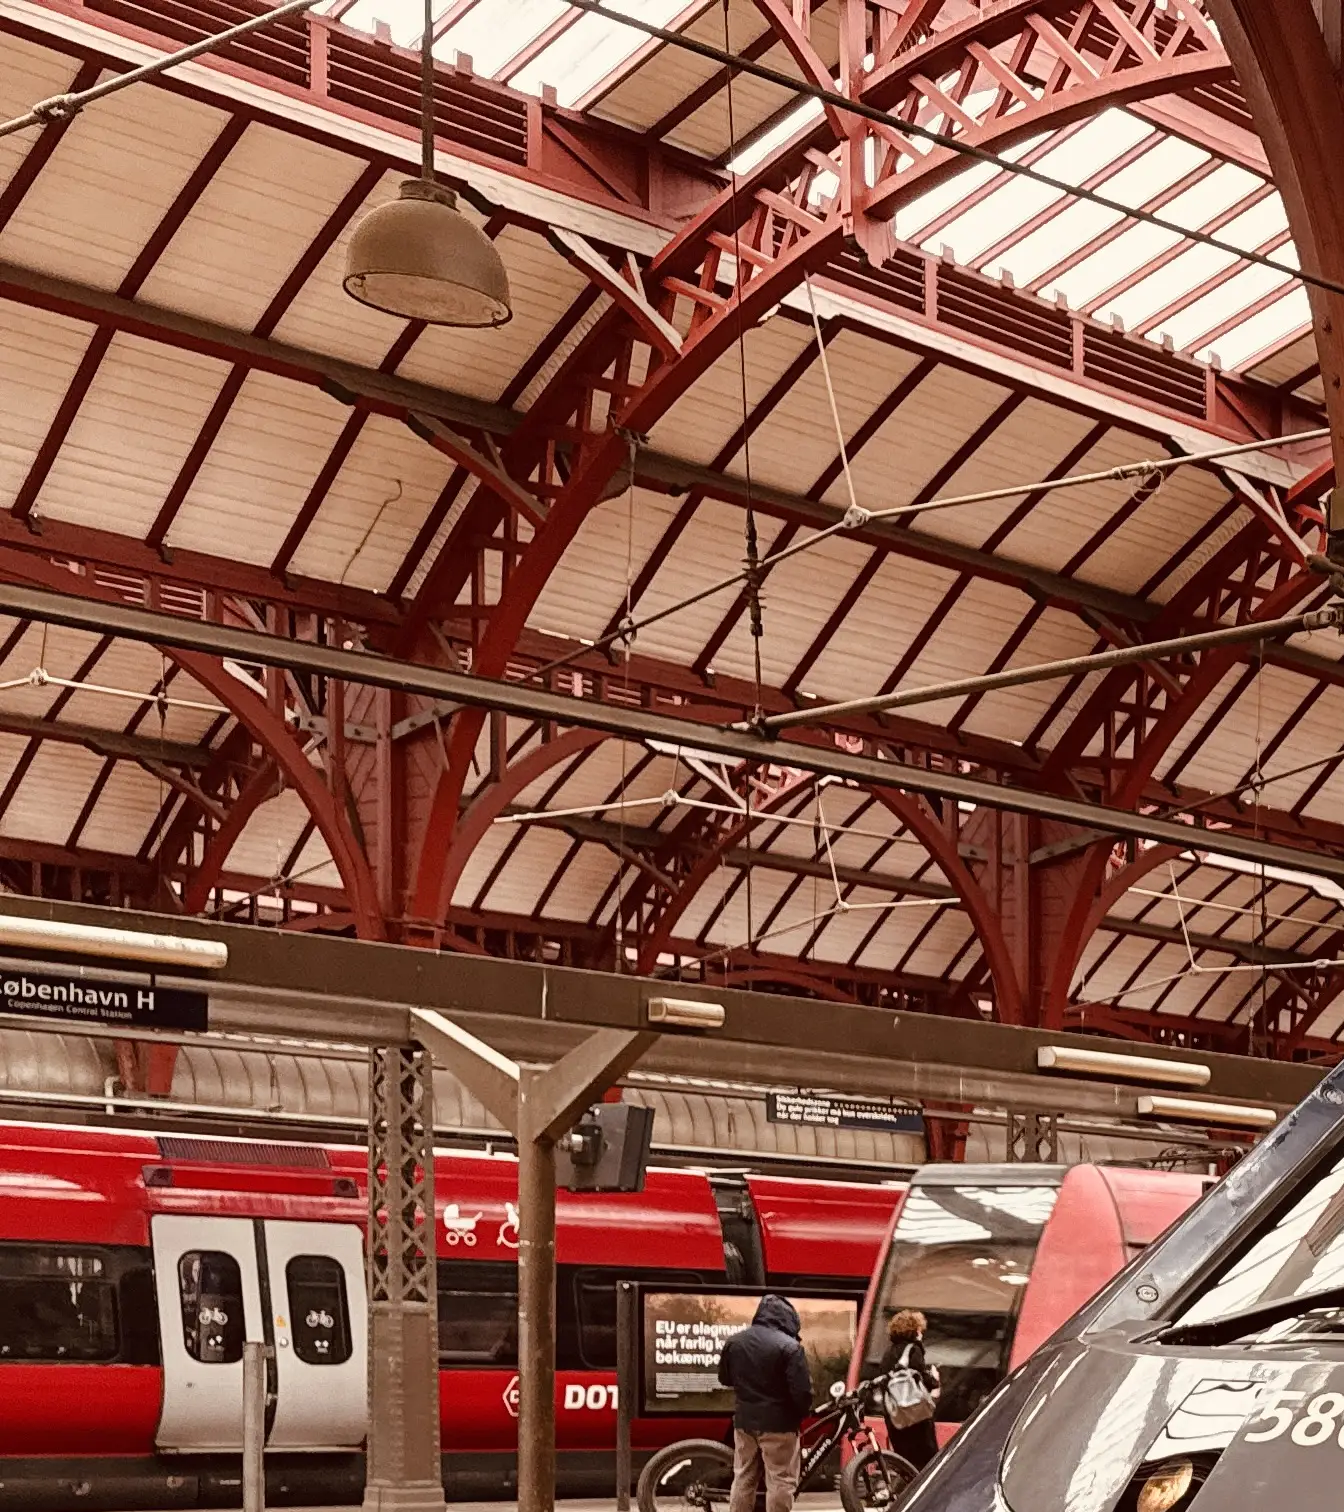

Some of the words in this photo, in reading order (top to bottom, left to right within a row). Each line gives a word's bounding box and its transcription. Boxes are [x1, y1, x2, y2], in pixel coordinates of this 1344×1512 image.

[0, 975, 128, 1008] øbenhavn
[137, 990, 155, 1011] H
[8, 998, 64, 1013] Copenhagen
[66, 1004, 98, 1016] Central
[100, 1008, 133, 1020] Station
[655, 1320, 675, 1334] EU
[676, 1322, 691, 1335] er
[655, 1334, 678, 1349] når
[680, 1335, 714, 1352] farlig
